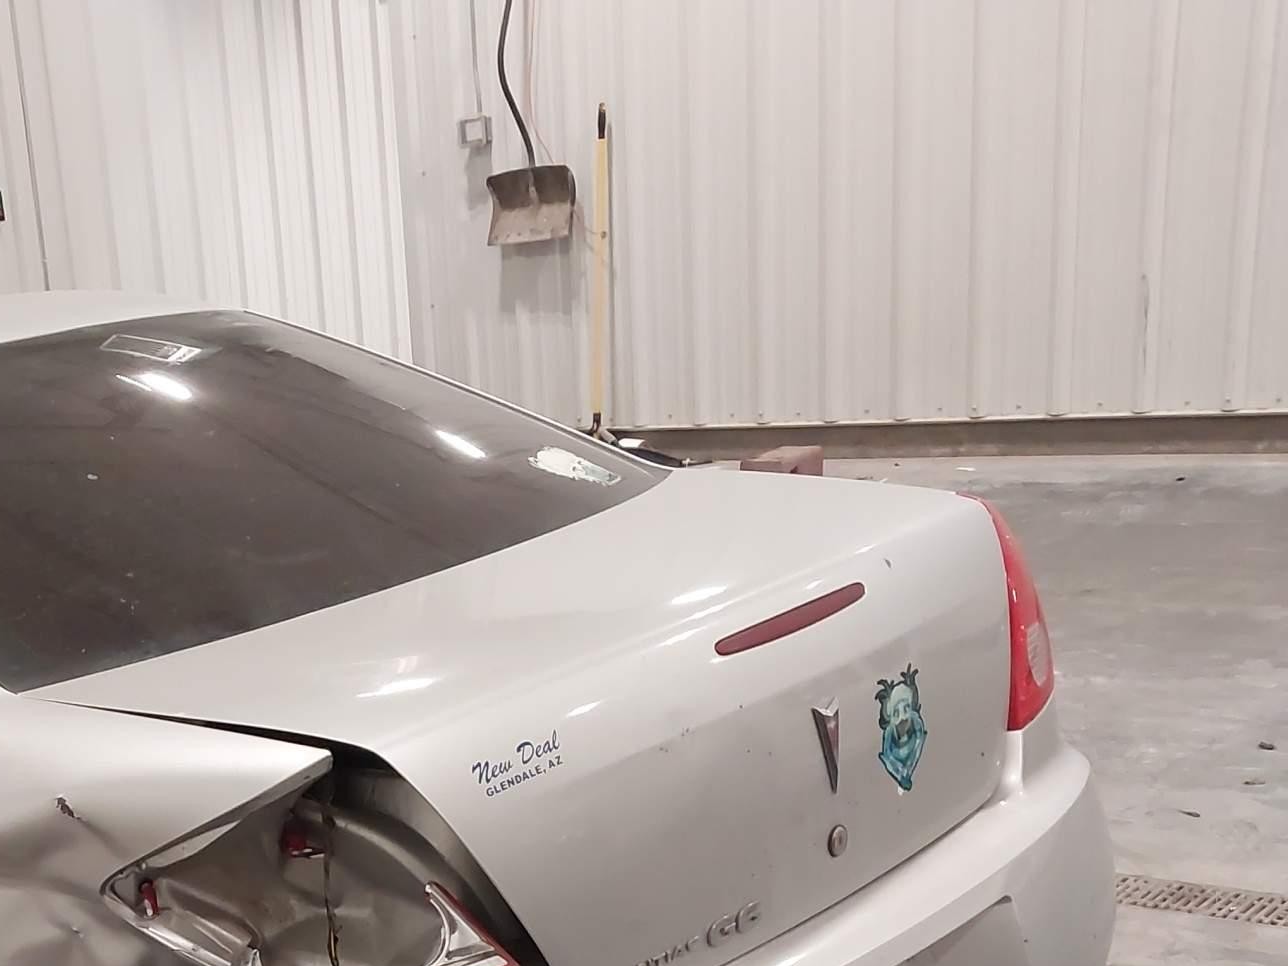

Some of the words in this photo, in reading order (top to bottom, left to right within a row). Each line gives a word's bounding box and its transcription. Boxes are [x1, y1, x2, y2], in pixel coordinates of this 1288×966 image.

[472, 760, 513, 784] New
[516, 729, 560, 765] Deal
[486, 765, 547, 797] GLENDALE,
[548, 755, 563, 769] AZ
